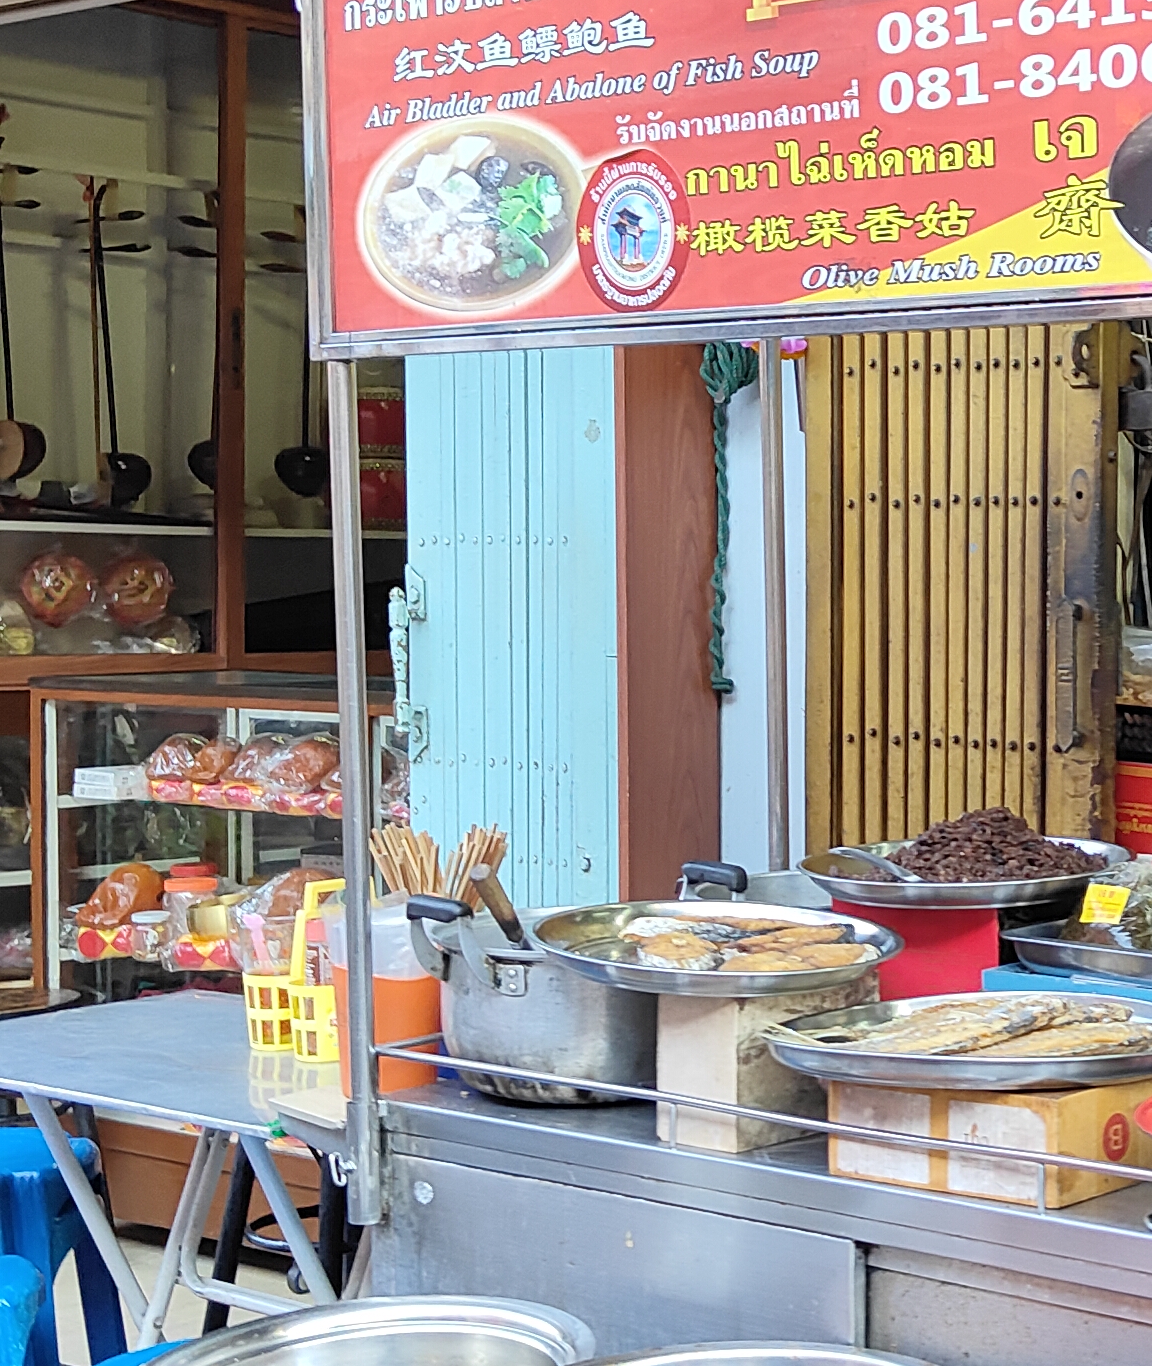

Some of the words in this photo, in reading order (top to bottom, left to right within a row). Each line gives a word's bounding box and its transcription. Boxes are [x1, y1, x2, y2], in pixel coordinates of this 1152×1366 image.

[364, 102, 401, 129] Air
[406, 93, 492, 123] Bladder
[497, 82, 541, 111] and
[546, 72, 646, 104] Abalone
[652, 61, 684, 95] of
[684, 53, 744, 86] Fish
[750, 49, 819, 78] Soup
[614, 79, 861, 145] รับจัดงานนอกสถานที่
[685, 126, 996, 198] กานาไฉ่เห็ดหอม
[1032, 112, 1100, 163] เจ
[800, 263, 880, 292] Olive
[886, 254, 979, 286] Mush
[986, 250, 1101, 279] Rooms
